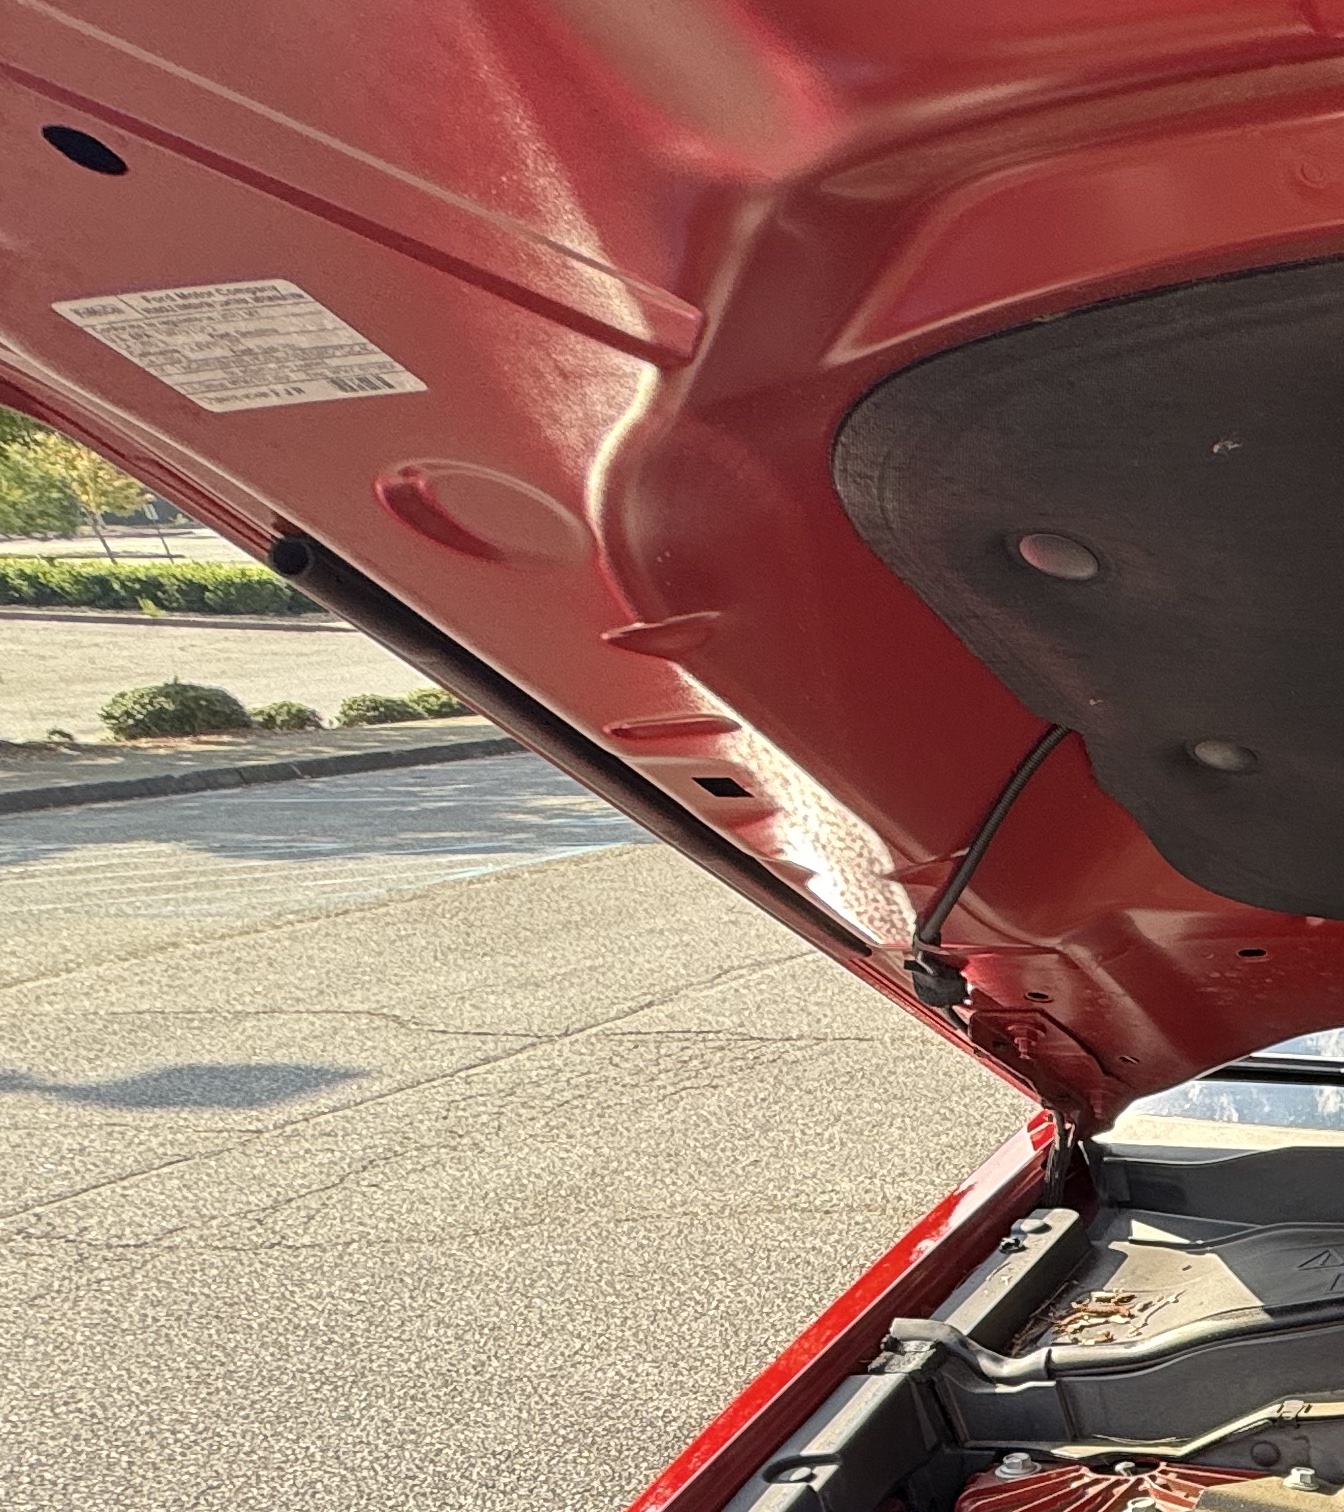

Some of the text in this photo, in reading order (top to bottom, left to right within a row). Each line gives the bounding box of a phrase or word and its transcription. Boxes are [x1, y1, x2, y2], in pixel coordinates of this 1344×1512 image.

[141, 292, 175, 304] Ford
[175, 289, 215, 301] Motor
[218, 285, 283, 297] Company
